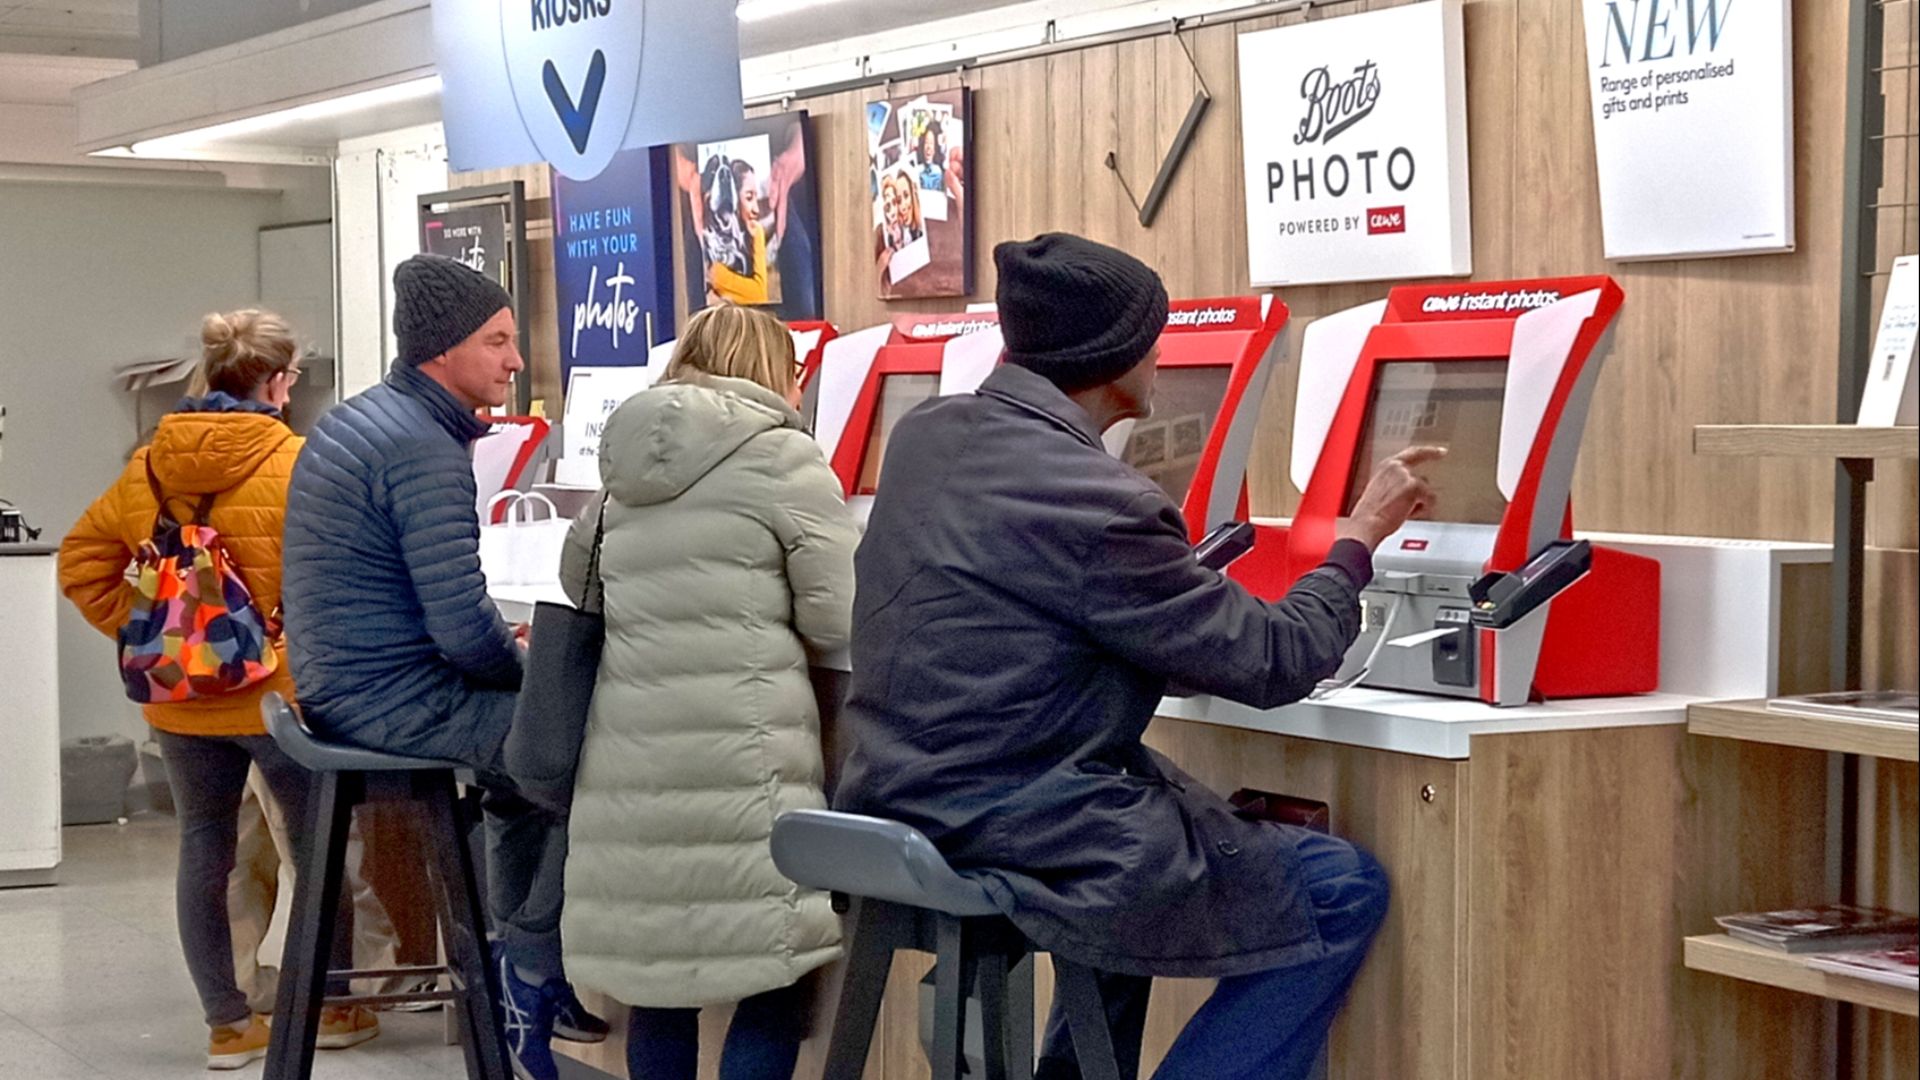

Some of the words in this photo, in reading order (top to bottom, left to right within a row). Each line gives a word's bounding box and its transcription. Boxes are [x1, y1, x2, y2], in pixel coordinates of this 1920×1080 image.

[1599, 0, 1733, 68] NEW
[1600, 76, 1638, 95] Range
[1640, 69, 1653, 87] of
[1655, 58, 1734, 90] personalised
[1293, 59, 1381, 145] Boots
[1602, 96, 1626, 119] gifts
[1629, 92, 1652, 111] and
[1655, 89, 1689, 112] prints
[1267, 146, 1415, 203] PHOTO
[569, 210, 600, 232] HAVE
[605, 206, 632, 229] FUN
[1279, 218, 1339, 236] POWERED
[1345, 216, 1360, 231] BY
[567, 238, 597, 258] WITH
[602, 233, 638, 255] YOUR
[571, 261, 640, 359] photos
[1460, 291, 1509, 311] instant
[1504, 289, 1560, 312] photos
[1167, 309, 1199, 325] nstant
[1195, 306, 1237, 327] photos
